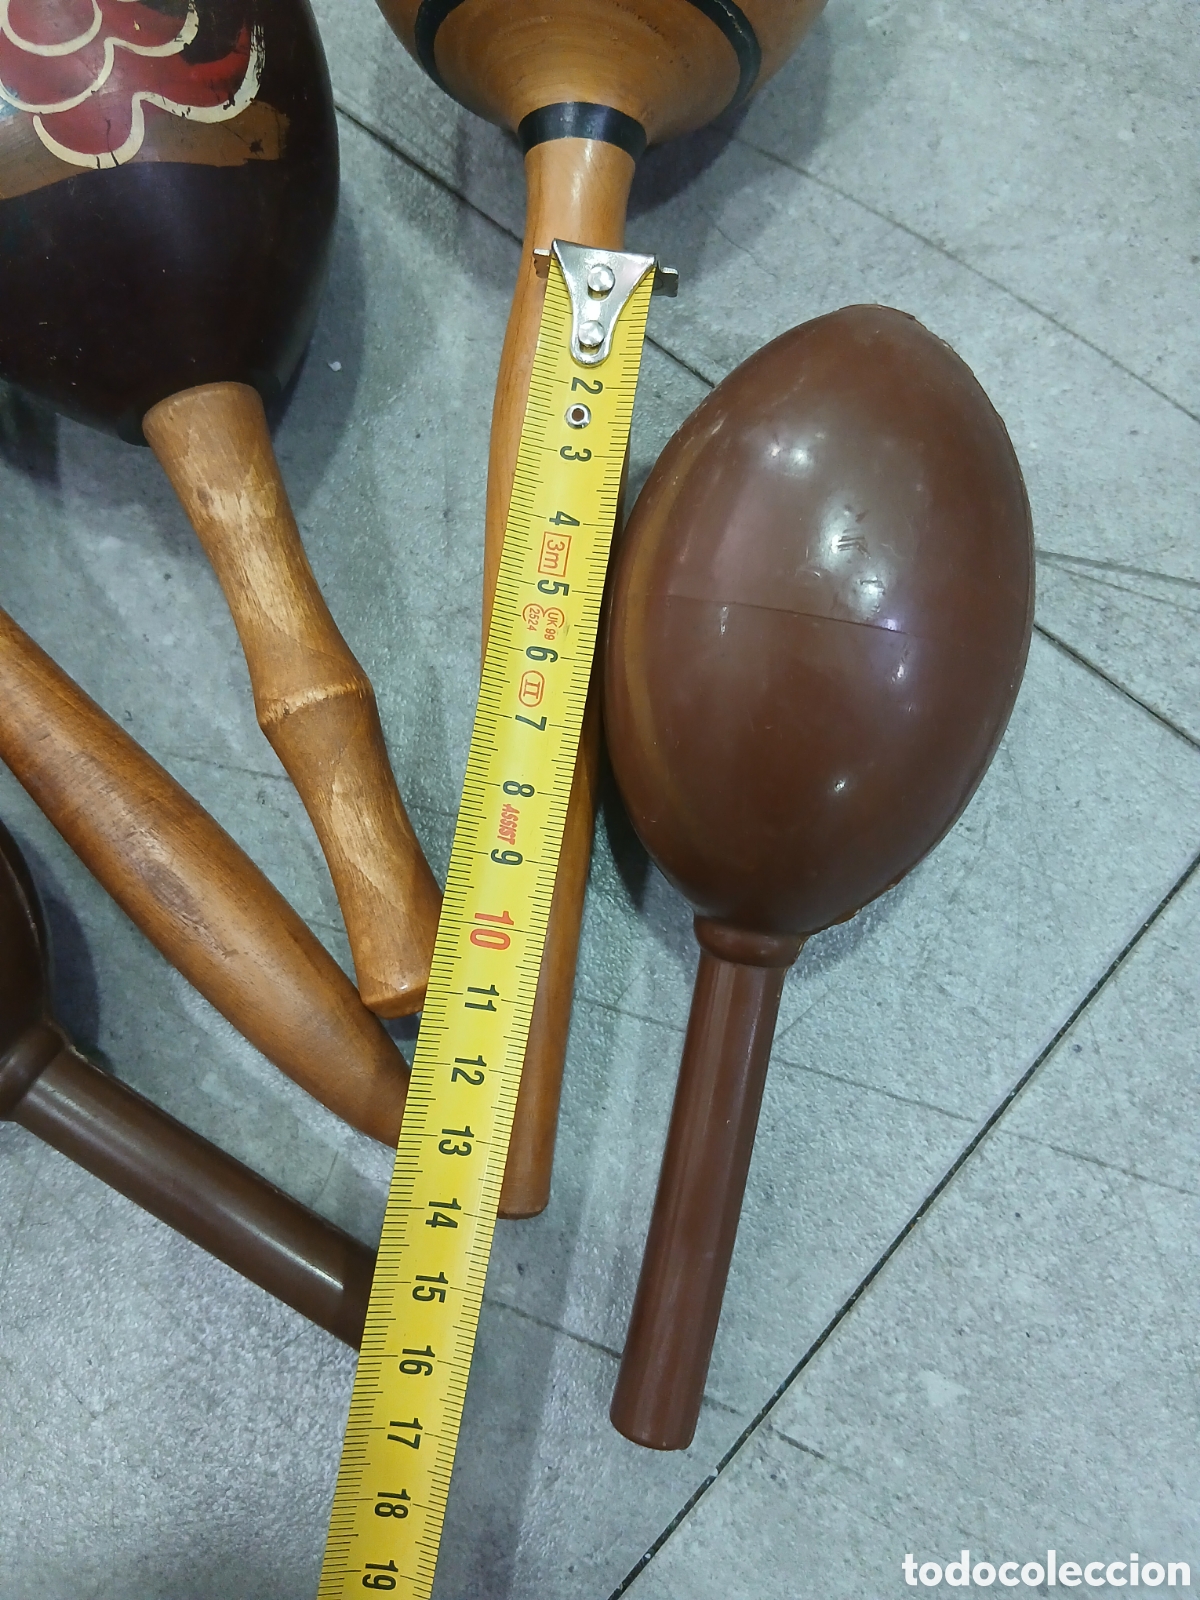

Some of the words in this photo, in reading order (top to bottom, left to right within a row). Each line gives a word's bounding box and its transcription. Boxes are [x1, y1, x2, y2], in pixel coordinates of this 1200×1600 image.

[571, 377, 603, 395] 2
[560, 445, 592, 462] 3
[549, 510, 581, 527] 4
[543, 539, 565, 570] 3m
[537, 579, 570, 596] 5
[525, 645, 559, 663] 6
[515, 714, 547, 732] 7
[502, 780, 535, 798] 8
[490, 848, 524, 866] 9
[470, 910, 515, 951] 10
[464, 984, 500, 1012] 11
[451, 1055, 487, 1086] 12
[438, 1125, 474, 1157] 13
[425, 1198, 462, 1229] 14
[412, 1271, 449, 1303] 15
[398, 1345, 436, 1376] 16
[387, 1417, 423, 1450] 17
[374, 1488, 411, 1519] 18
[362, 1559, 399, 1591] 19
